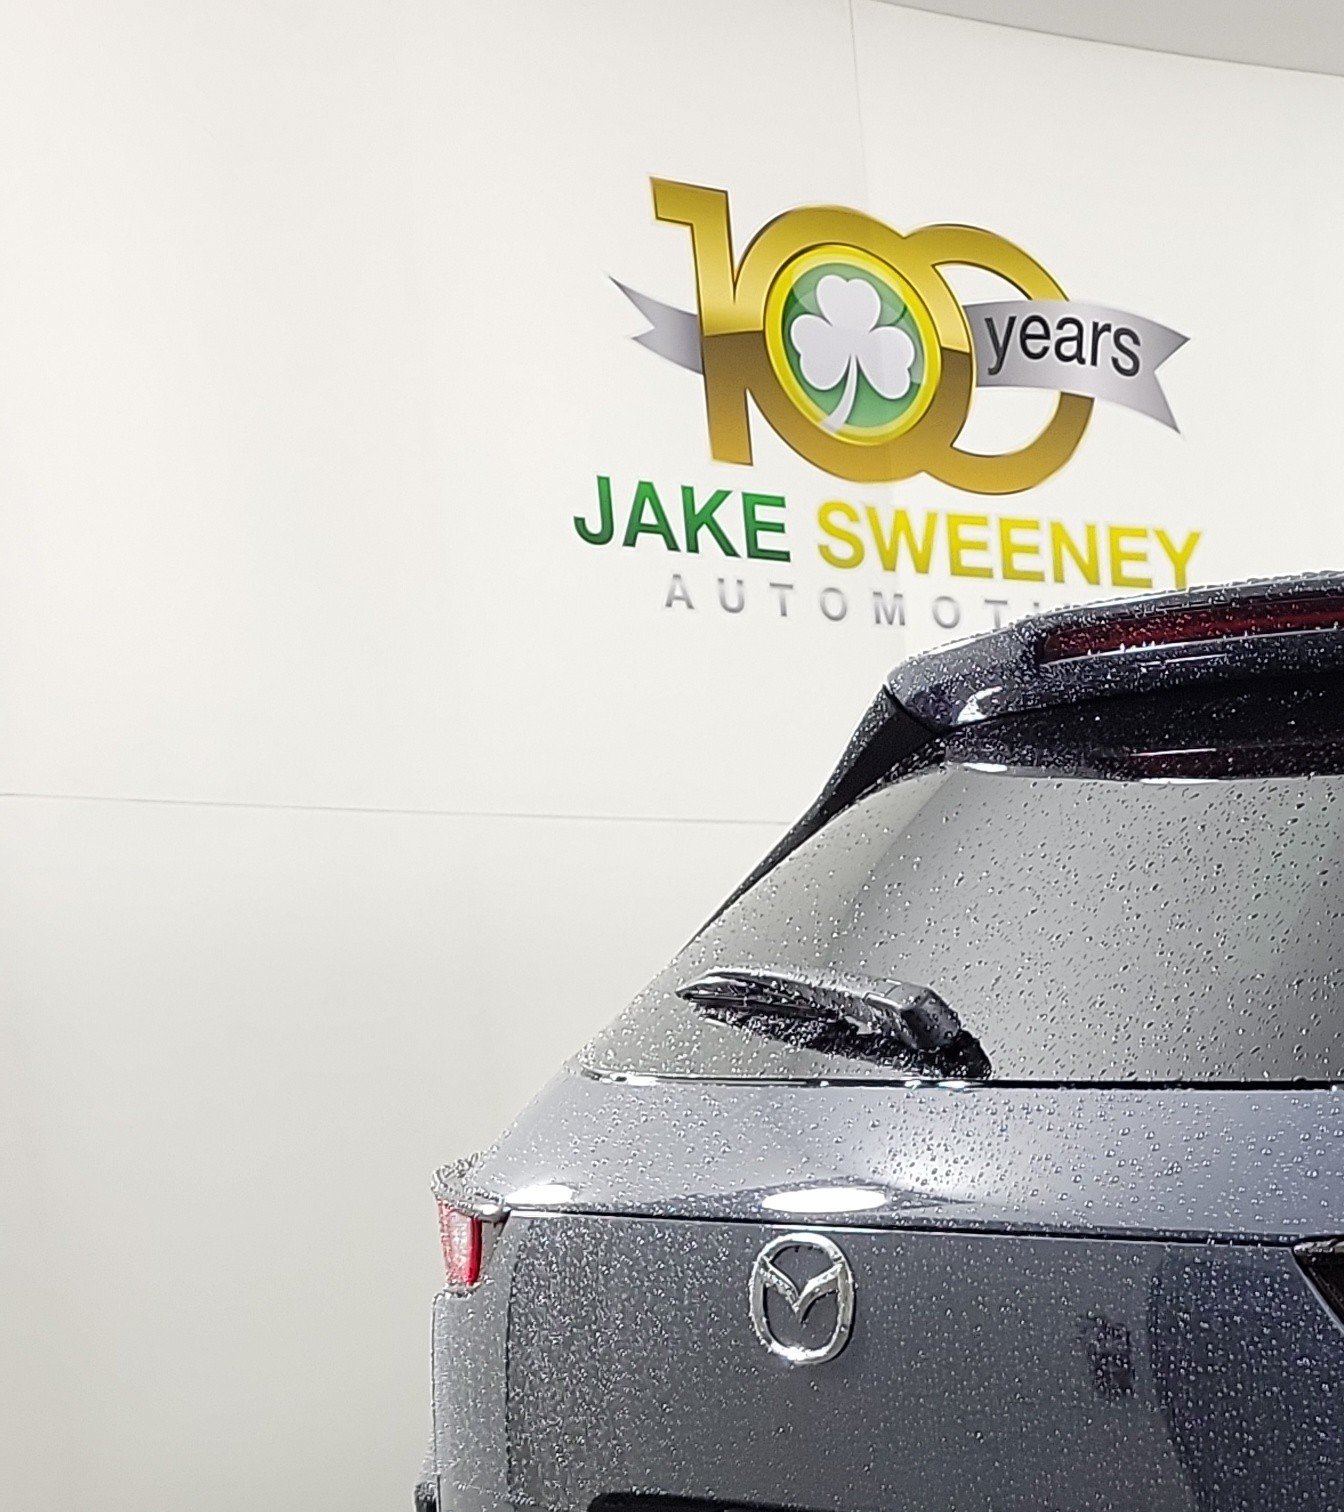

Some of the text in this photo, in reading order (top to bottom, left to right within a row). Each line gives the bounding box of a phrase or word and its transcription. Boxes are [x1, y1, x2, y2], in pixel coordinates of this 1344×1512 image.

[649, 175, 1143, 496] 100 years
[573, 475, 1202, 590] JAKE SWEENEY
[663, 573, 1041, 630] AUTOMOT
